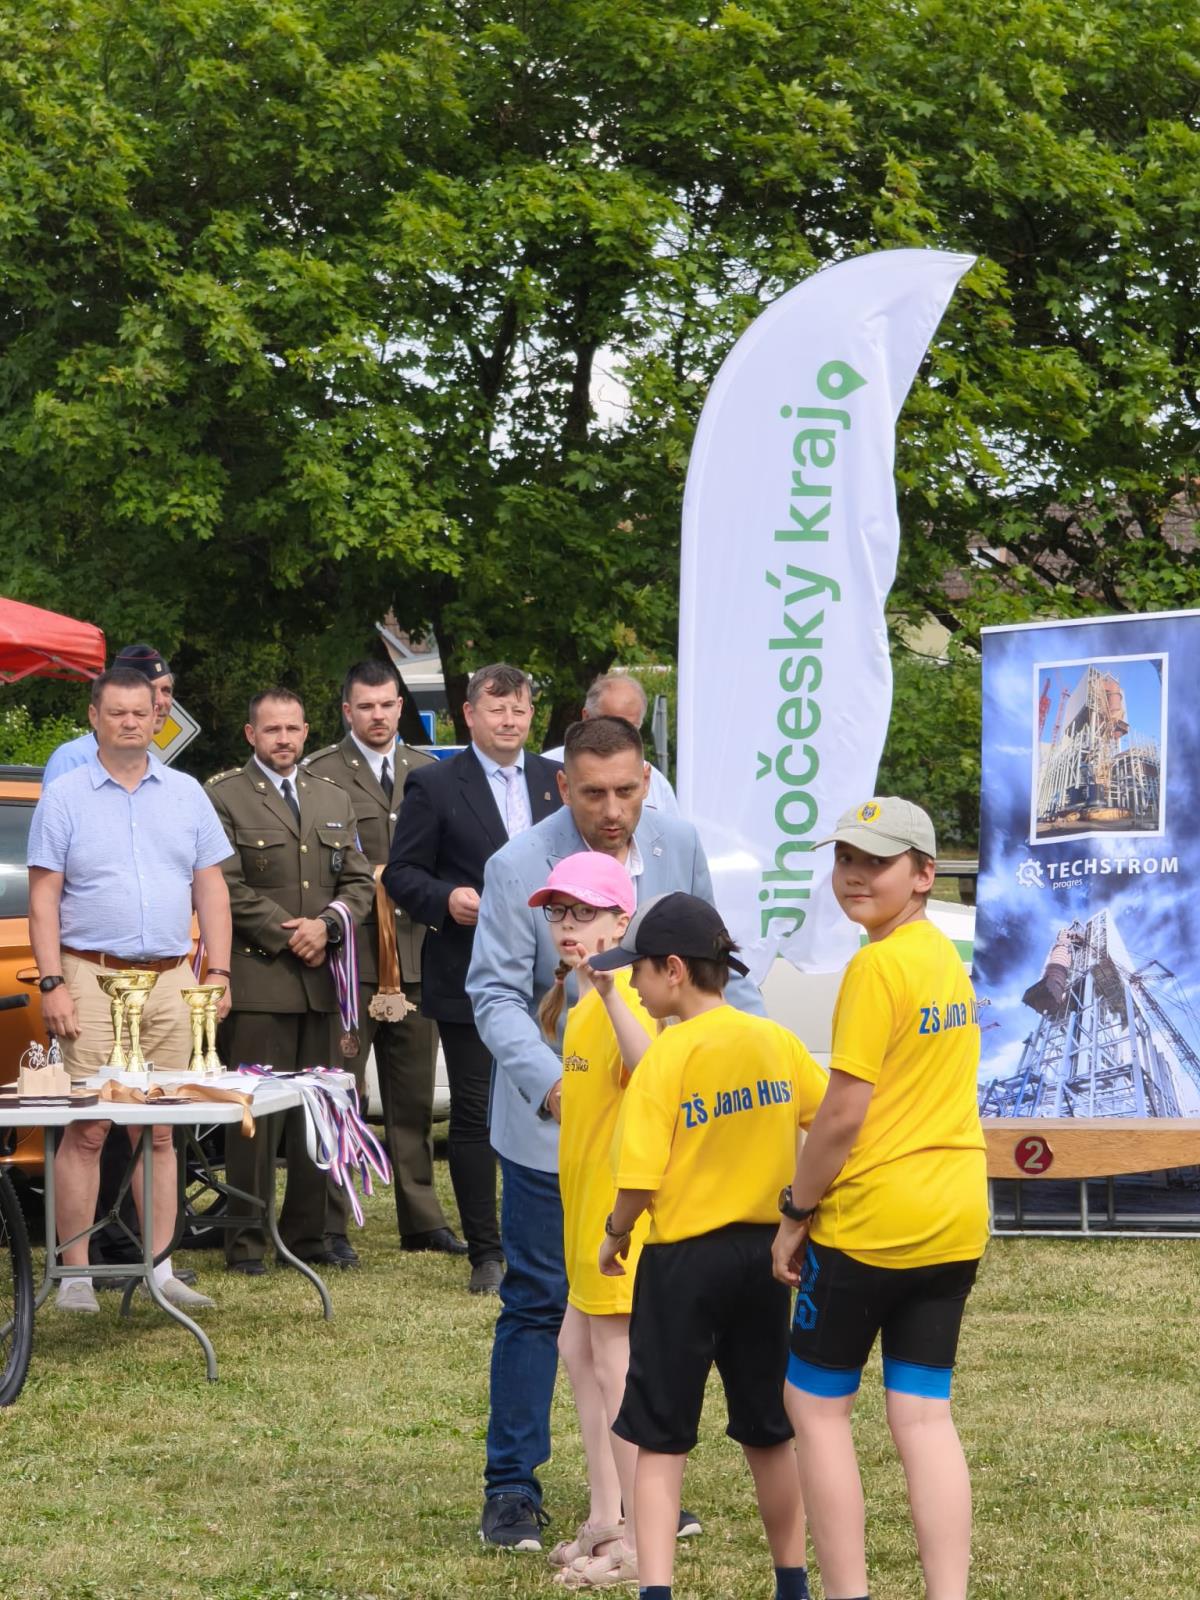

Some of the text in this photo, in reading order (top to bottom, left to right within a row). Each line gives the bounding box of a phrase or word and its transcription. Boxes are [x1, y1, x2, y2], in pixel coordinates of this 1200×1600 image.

[756, 404, 851, 938] Jihočeský kraj
[1046, 857, 1179, 880] TECHSTROM
[1052, 878, 1083, 891] progres
[681, 1079, 793, 1128] ZŠ Jana Hus
[1024, 1140, 1044, 1169] 2
